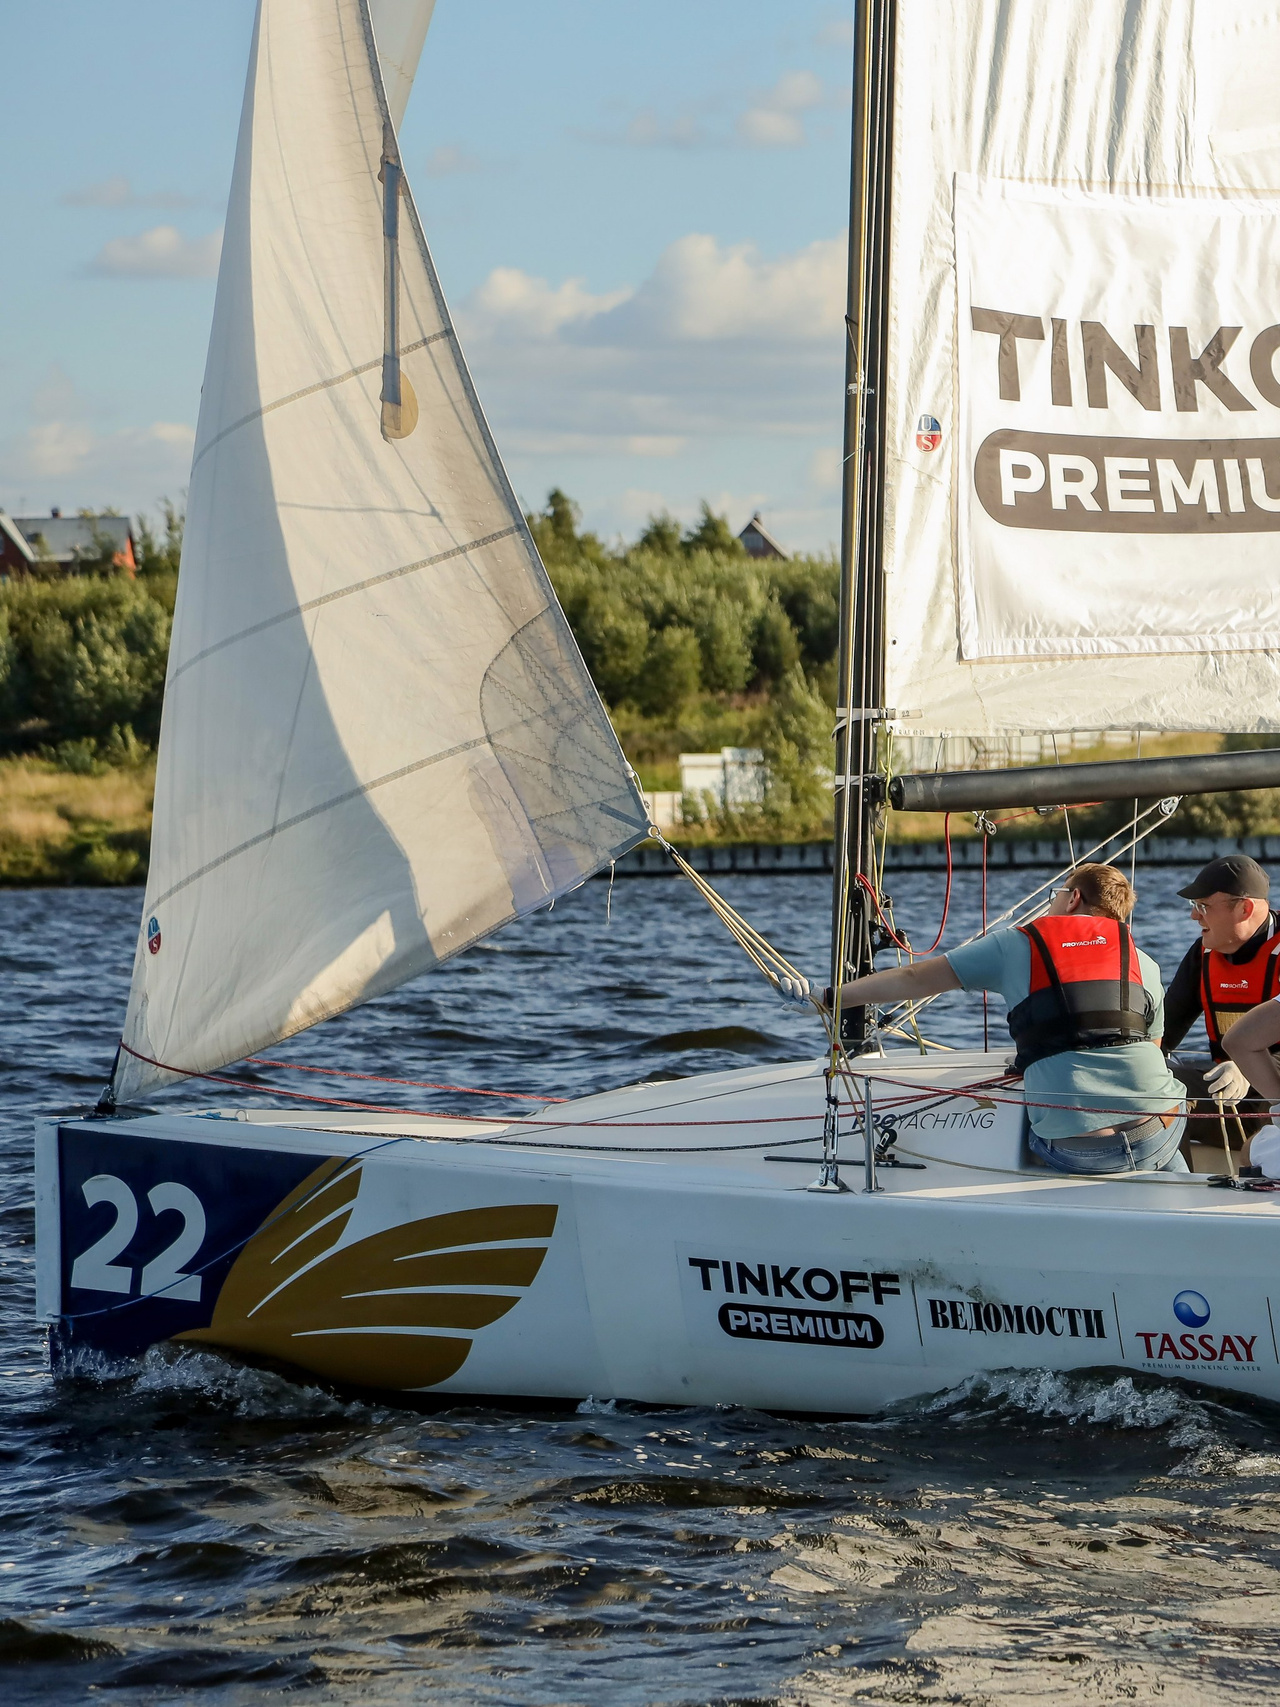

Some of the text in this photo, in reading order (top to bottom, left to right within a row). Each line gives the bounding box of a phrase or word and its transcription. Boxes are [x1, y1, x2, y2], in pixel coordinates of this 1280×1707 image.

[71, 1174, 206, 1302] 22
[688, 1257, 901, 1305] TINKOFF
[729, 1309, 874, 1343] PREMIUM
[927, 1298, 1108, 1338] ВЕДОМОСТИ
[1134, 1332, 1258, 1362] TASSAY
